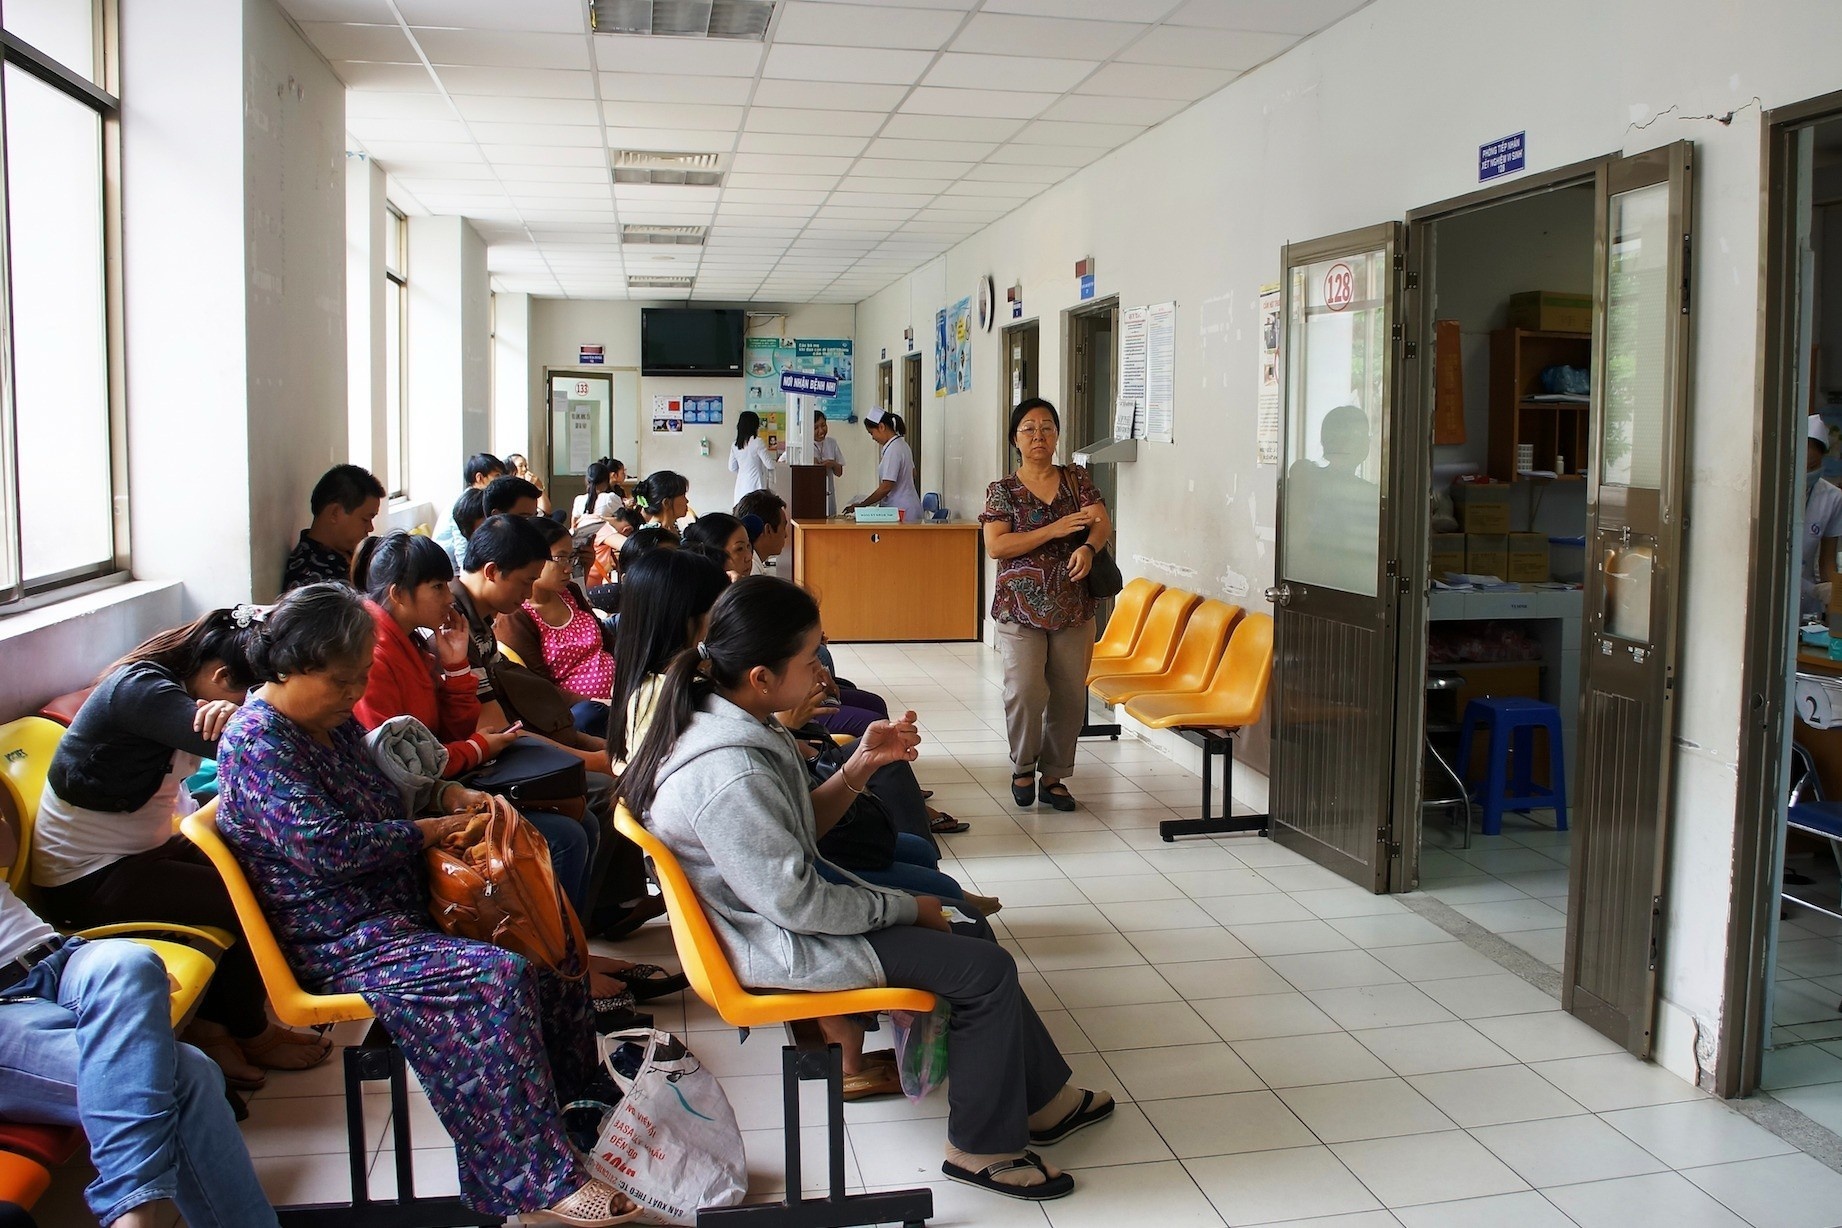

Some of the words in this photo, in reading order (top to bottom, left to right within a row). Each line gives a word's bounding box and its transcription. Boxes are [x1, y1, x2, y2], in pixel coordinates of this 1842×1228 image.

[1328, 272, 1350, 304] 128
[577, 384, 588, 394] 133
[794, 376, 809, 390] NHẬN
[1806, 696, 1820, 723] 2
[629, 1186, 647, 1202] THEO
